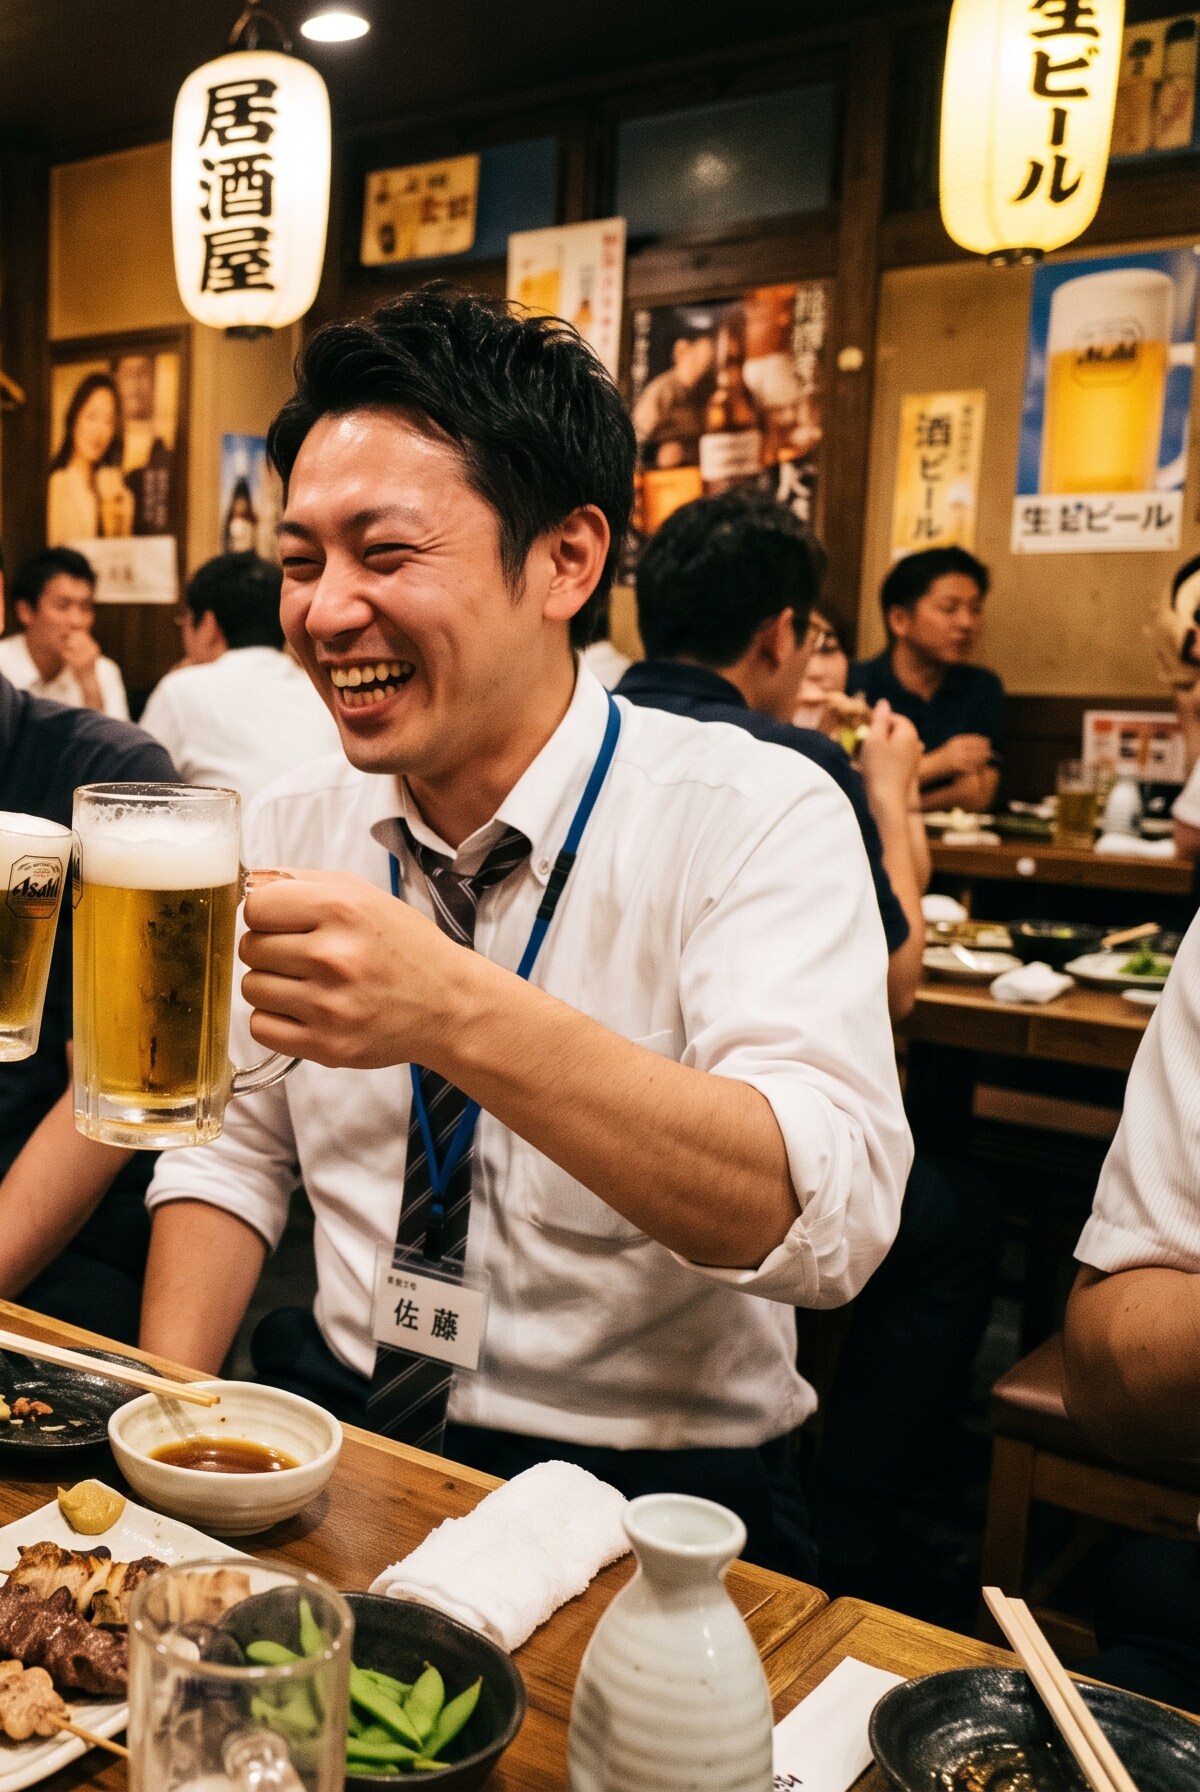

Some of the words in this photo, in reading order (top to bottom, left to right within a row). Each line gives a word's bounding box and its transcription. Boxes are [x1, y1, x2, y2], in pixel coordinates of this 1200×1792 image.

[1014, 0, 1099, 203] 生ビール
[199, 78, 277, 293] 居酒屋
[11, 876, 61, 898] Asahi
[394, 1297, 459, 1342] 佐藤
